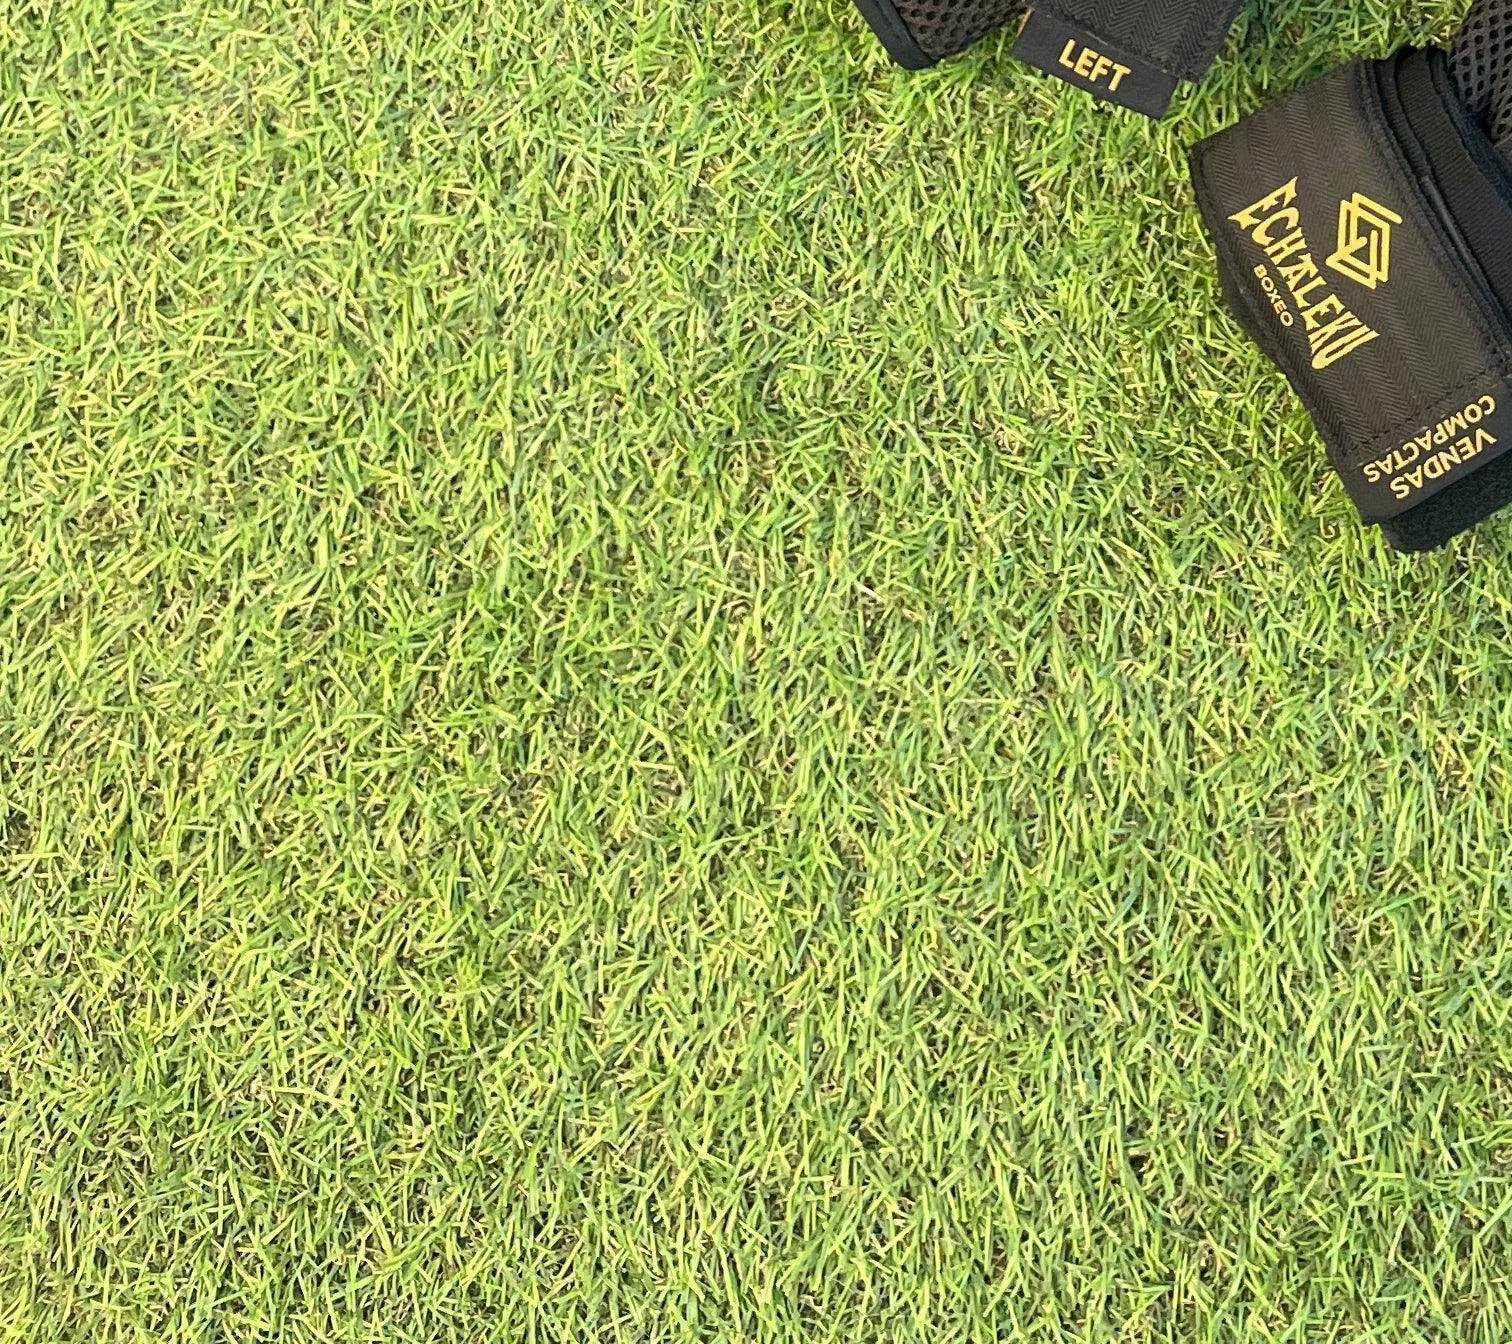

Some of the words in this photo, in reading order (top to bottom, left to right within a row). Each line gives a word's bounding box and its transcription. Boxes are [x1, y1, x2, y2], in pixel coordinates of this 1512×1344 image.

[1058, 39, 1132, 91] LEFT
[1228, 176, 1380, 369] ECHALEKU
[1253, 264, 1293, 327] BOXEO
[1363, 395, 1496, 483] COMPACTAS
[1390, 428, 1496, 500] VENDAS
